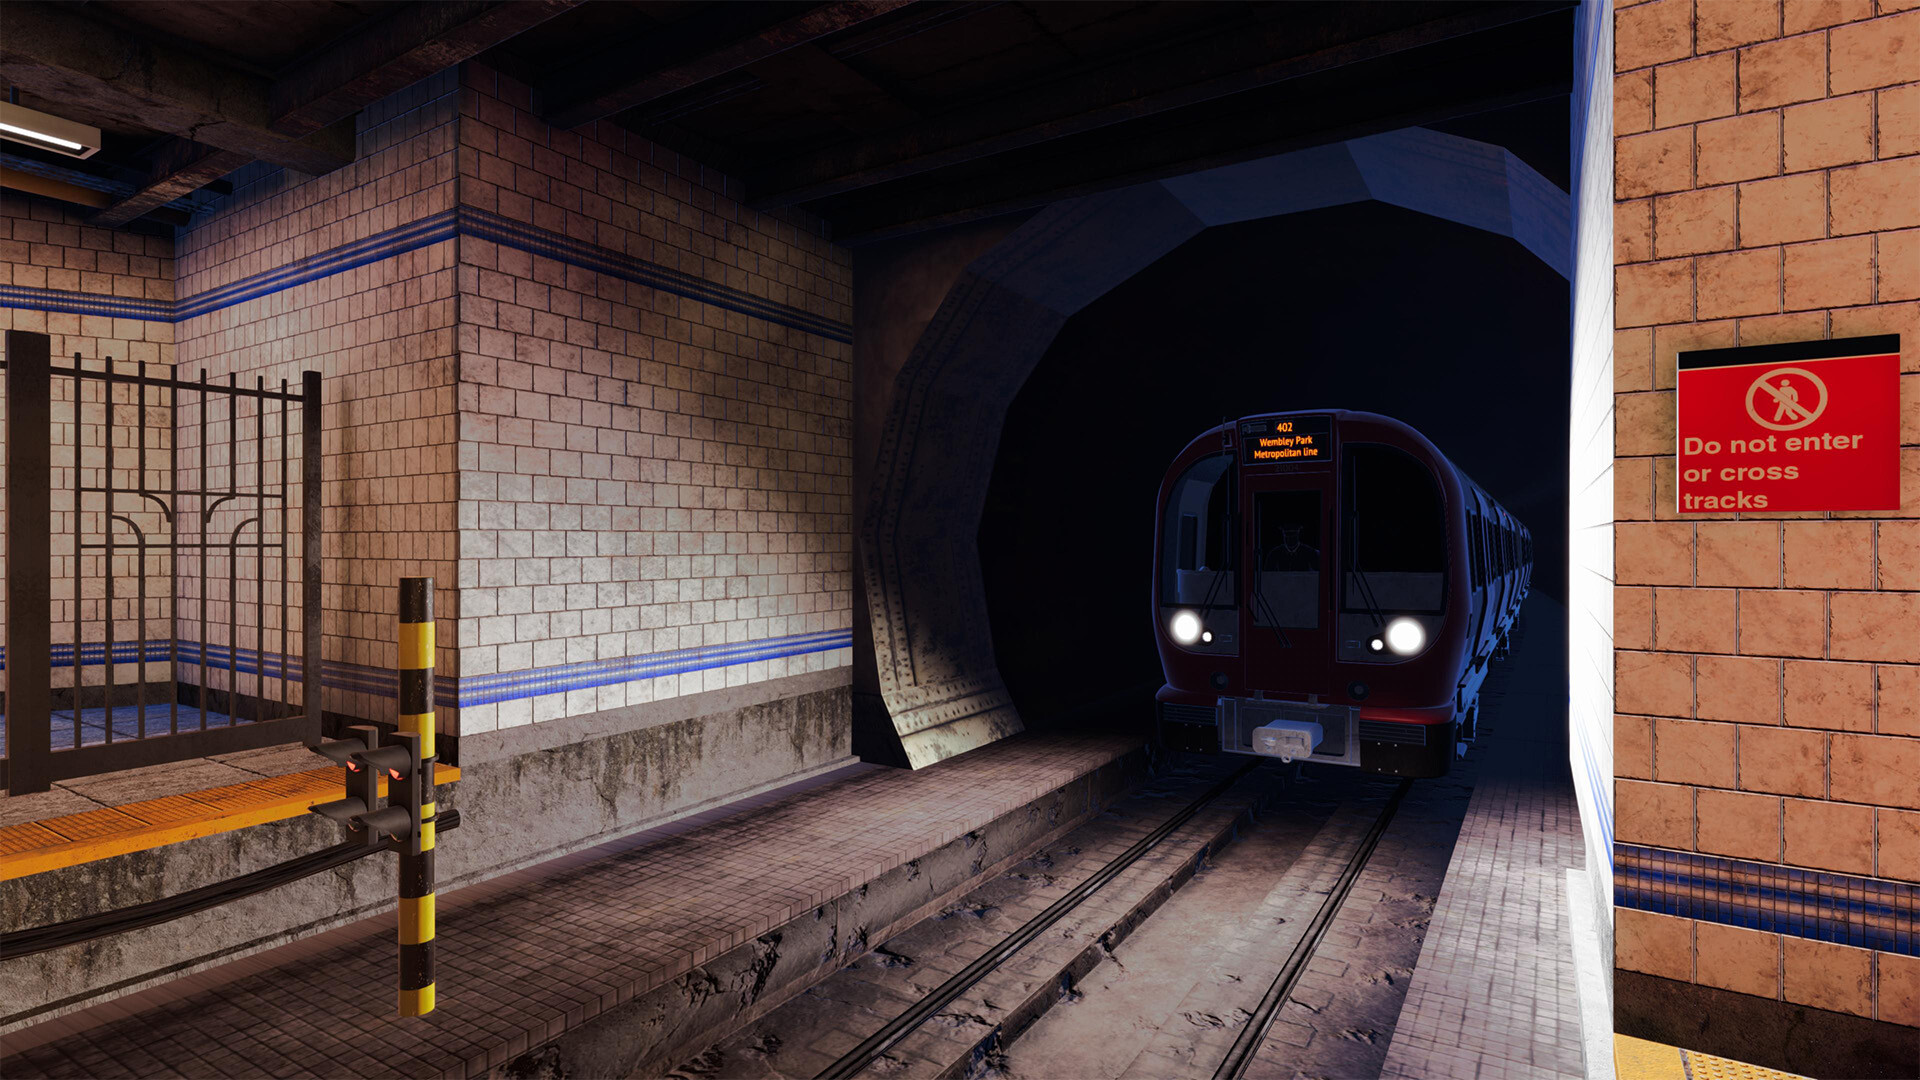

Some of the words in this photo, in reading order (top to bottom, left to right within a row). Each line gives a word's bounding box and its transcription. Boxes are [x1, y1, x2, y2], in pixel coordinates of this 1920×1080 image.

[1276, 421, 1293, 432] 402
[1259, 437, 1294, 448] Wembley
[1295, 435, 1313, 445] Park
[1684, 437, 1721, 455] Do
[1730, 435, 1777, 454] not
[1785, 432, 1864, 451] enter
[1254, 448, 1302, 460] Metropolitan
[1303, 447, 1318, 456] line
[1683, 468, 1712, 482] or
[1720, 465, 1800, 481] cross
[1683, 490, 1768, 509] tracks
